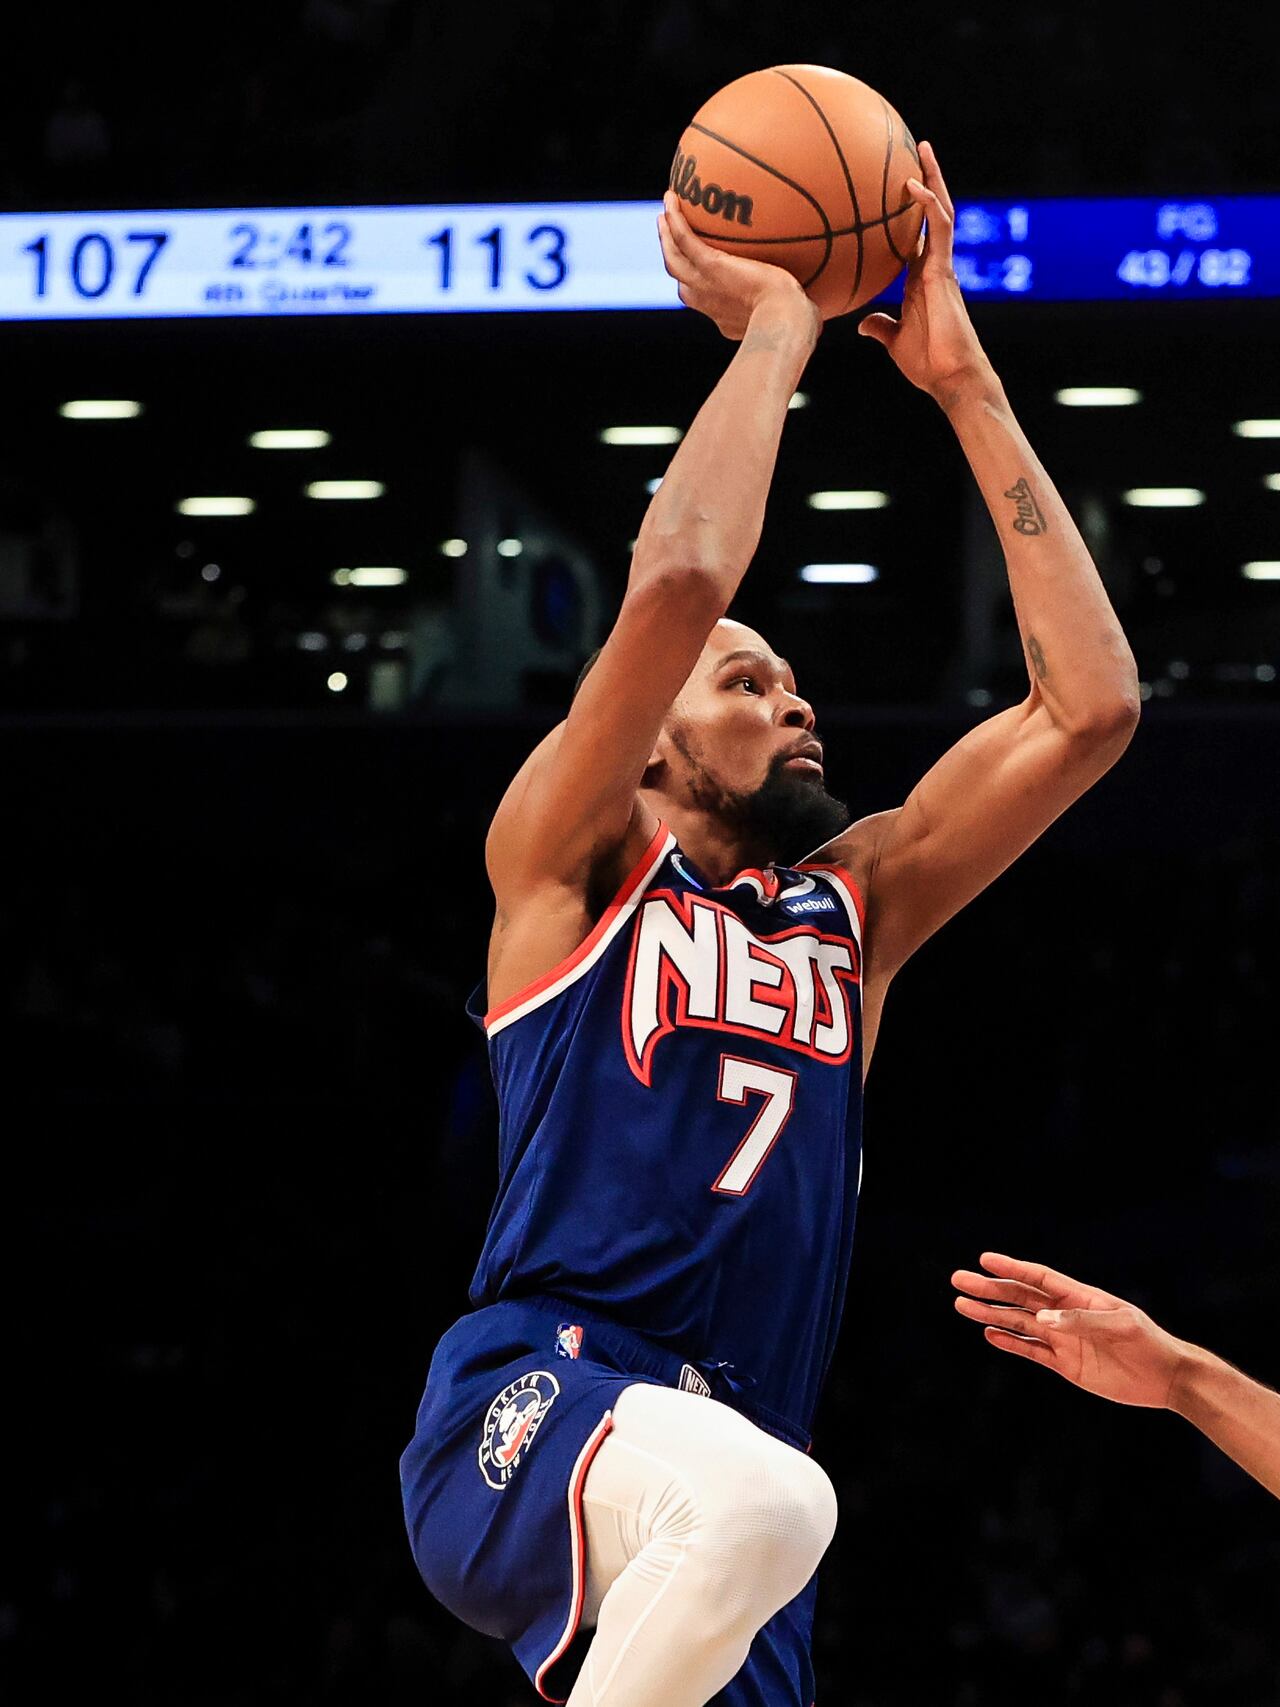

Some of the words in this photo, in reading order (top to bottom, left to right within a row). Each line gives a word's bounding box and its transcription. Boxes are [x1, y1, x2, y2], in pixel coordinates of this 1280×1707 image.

[21, 231, 169, 299] 107
[230, 222, 352, 268] 2:42
[424, 224, 569, 292] 113
[624, 891, 861, 1082] NETS
[711, 1053, 798, 1196] 7
